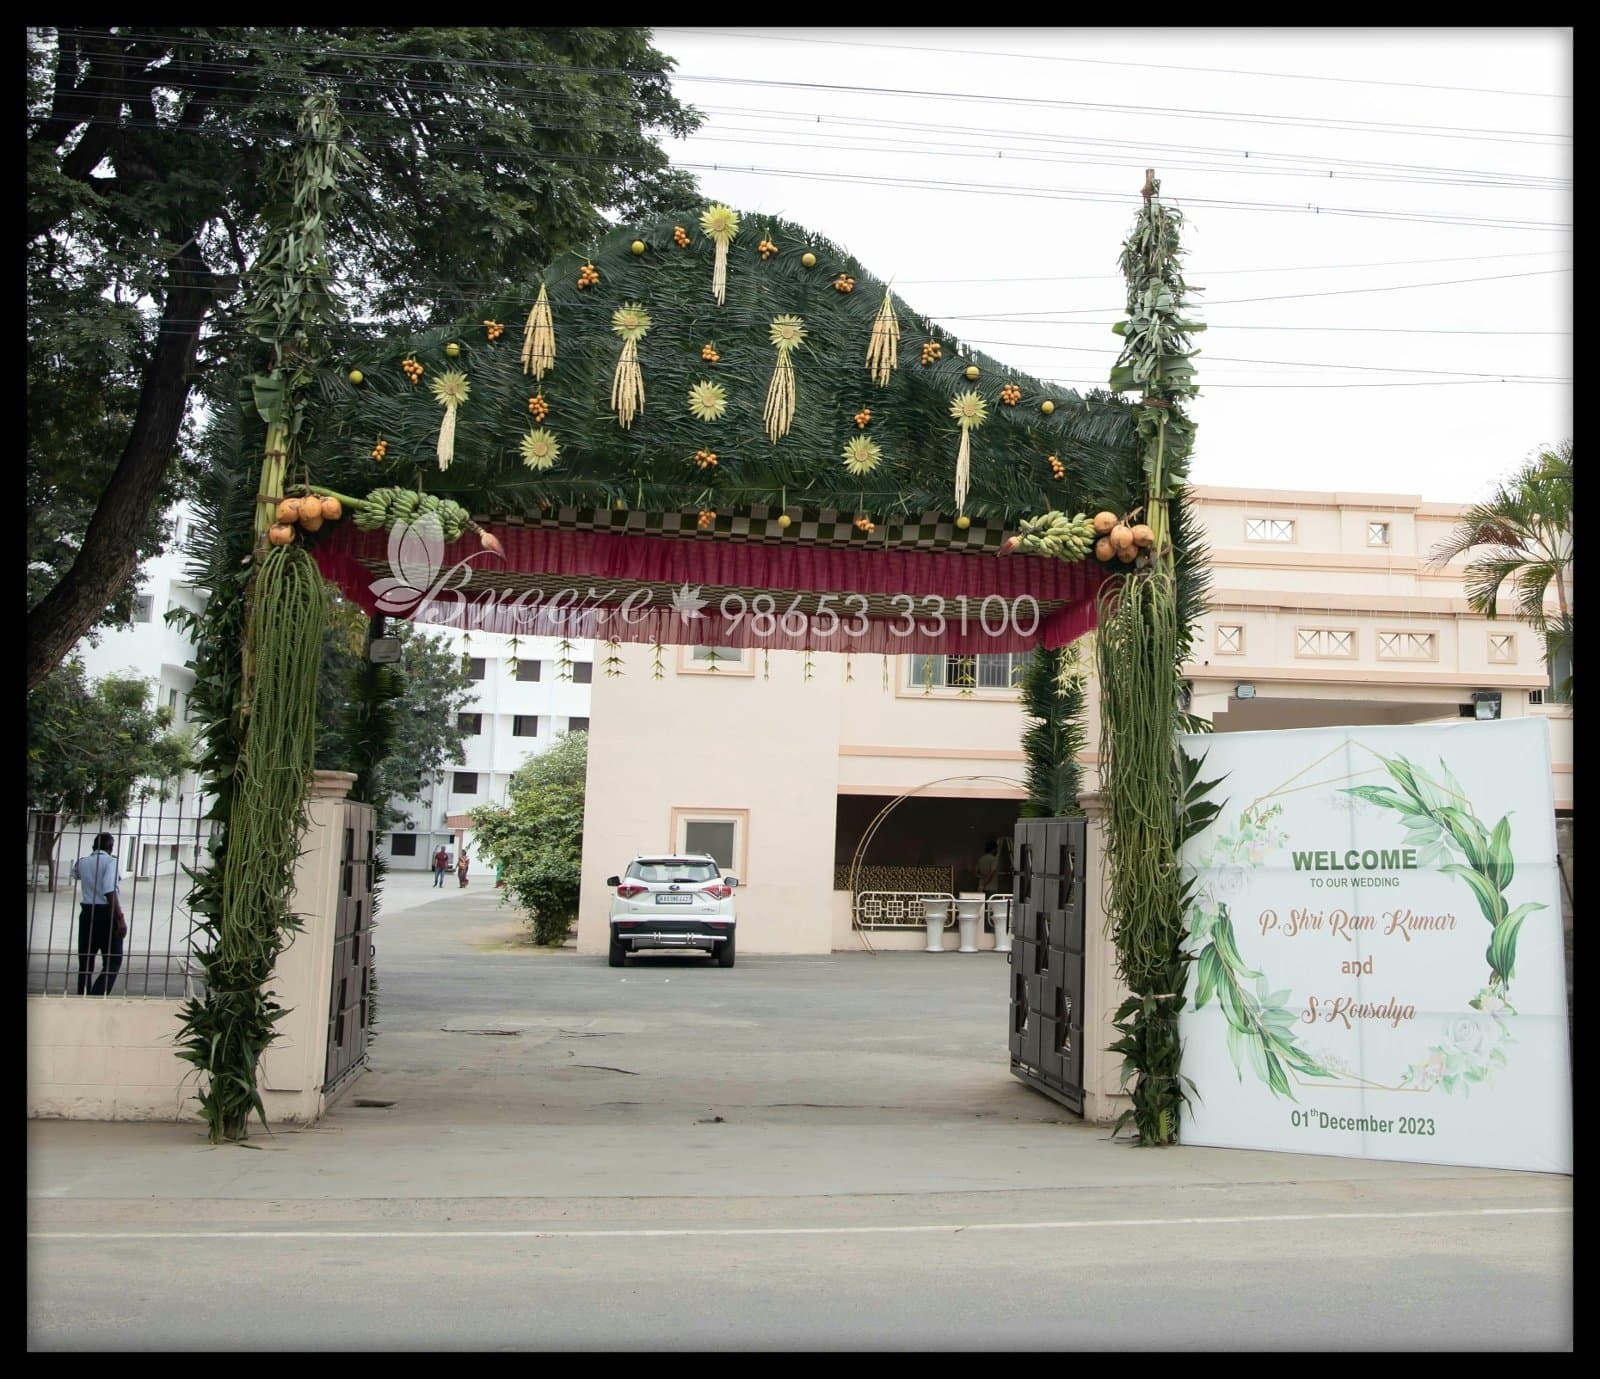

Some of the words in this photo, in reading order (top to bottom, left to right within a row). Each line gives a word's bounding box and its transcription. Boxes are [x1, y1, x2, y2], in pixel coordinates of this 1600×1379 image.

[1291, 848, 1418, 871] WELCOME
[1310, 878, 1324, 888] TO
[1326, 878, 1348, 888] OUR
[1350, 877, 1400, 888] WEDDING
[1328, 909, 1377, 942] Ram
[1382, 908, 1457, 942] Kumar
[1341, 955, 1374, 977] and
[1398, 1116, 1436, 1136] 2023
